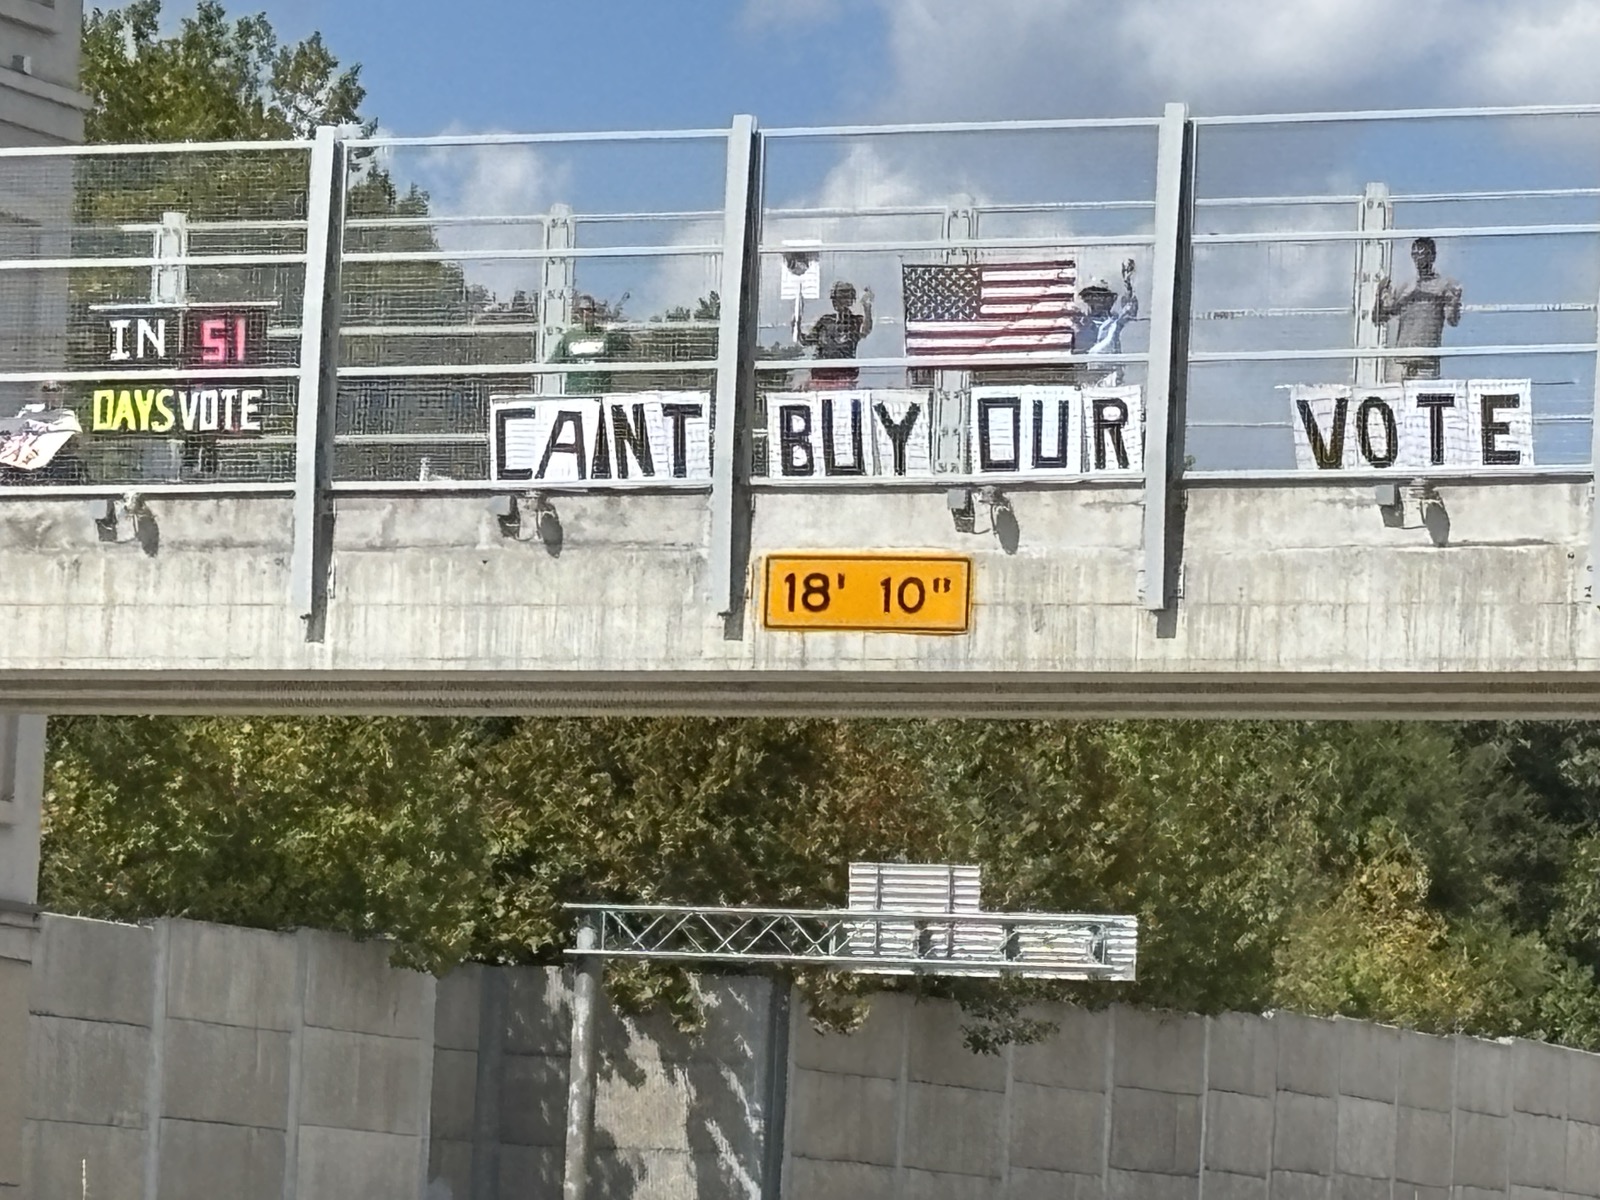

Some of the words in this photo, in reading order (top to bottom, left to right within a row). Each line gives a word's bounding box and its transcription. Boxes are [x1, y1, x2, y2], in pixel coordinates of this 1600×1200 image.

[109, 318, 166, 361] IN
[200, 318, 246, 362] 51
[92, 388, 175, 433] DAYS
[178, 388, 263, 432] VOTE
[495, 402, 702, 480] CANT
[779, 398, 921, 476] BUY
[977, 396, 1130, 472] OUR
[1296, 392, 1521, 470] VOTE
[784, 572, 846, 613] 18'
[880, 576, 952, 614] 10"
